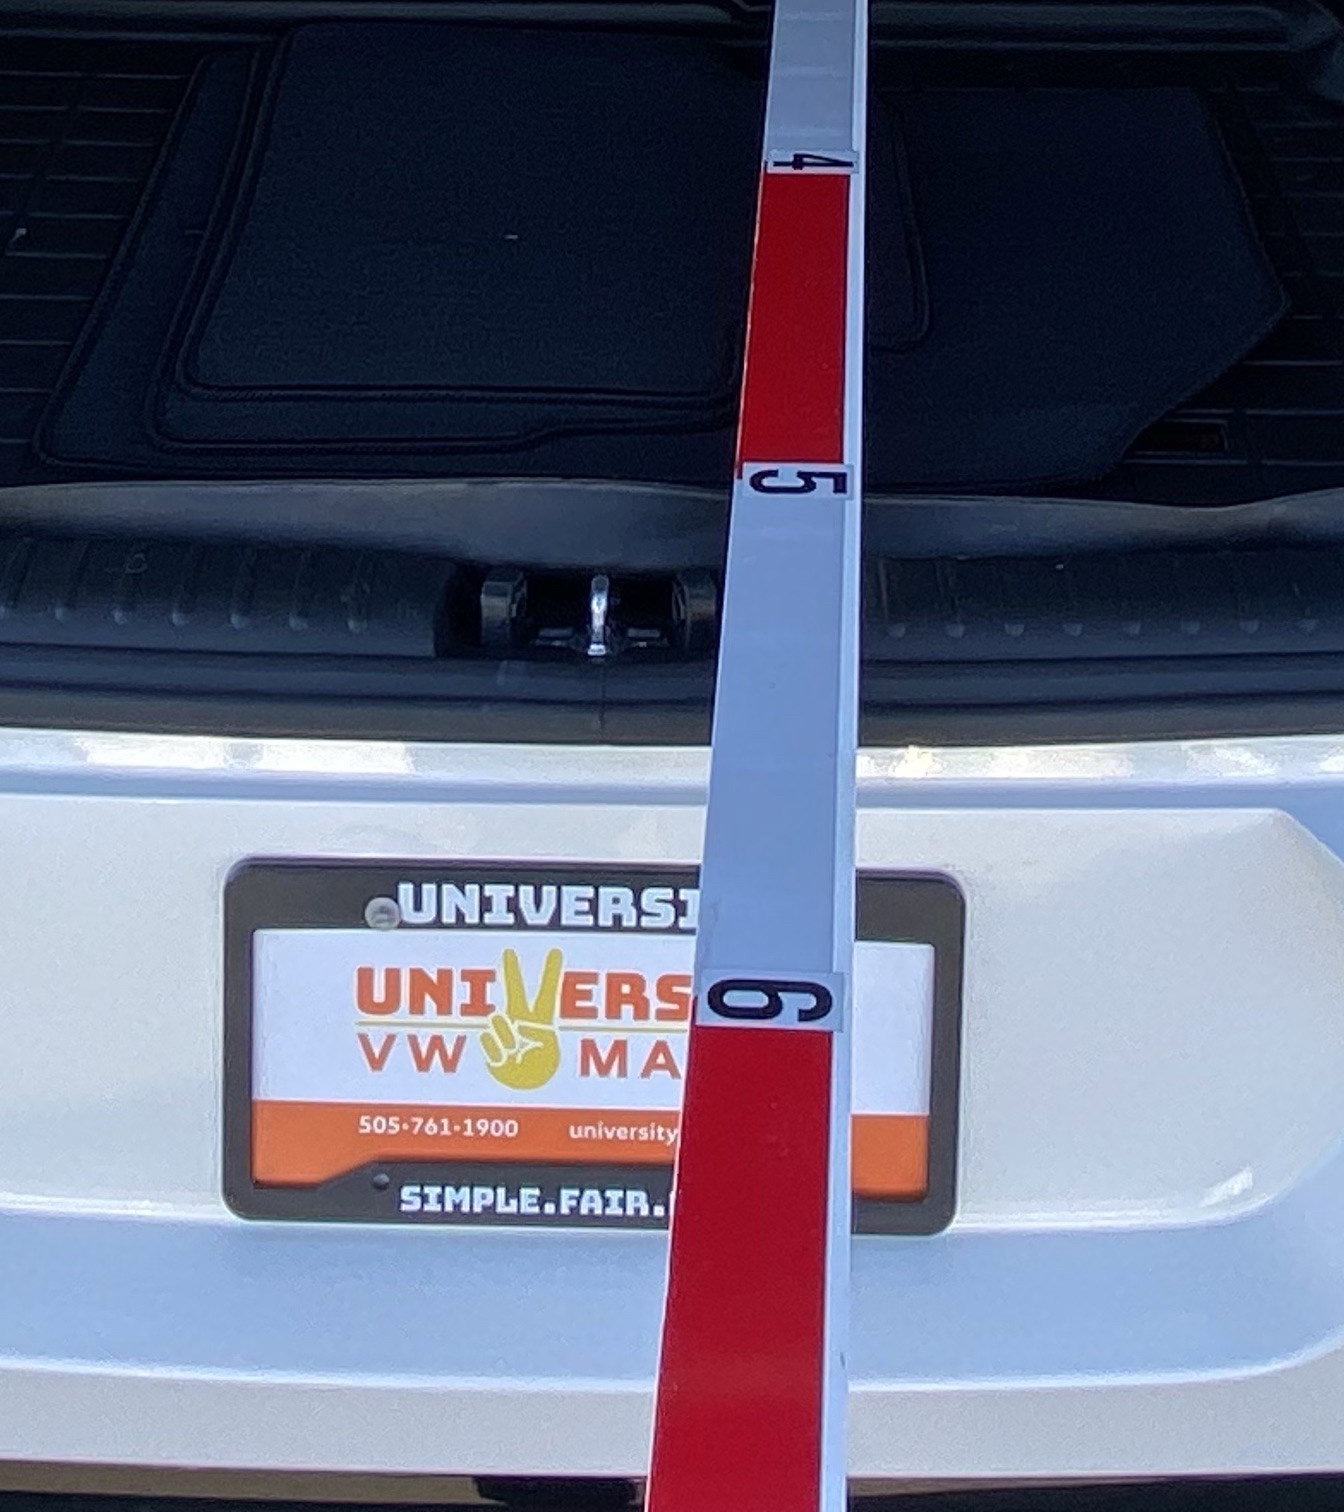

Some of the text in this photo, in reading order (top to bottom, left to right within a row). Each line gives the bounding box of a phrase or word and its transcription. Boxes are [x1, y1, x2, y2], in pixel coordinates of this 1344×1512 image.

[773, 153, 854, 171] 4
[749, 468, 848, 495] 5
[707, 979, 833, 1023] 6
[358, 1033, 683, 1080] VW MA
